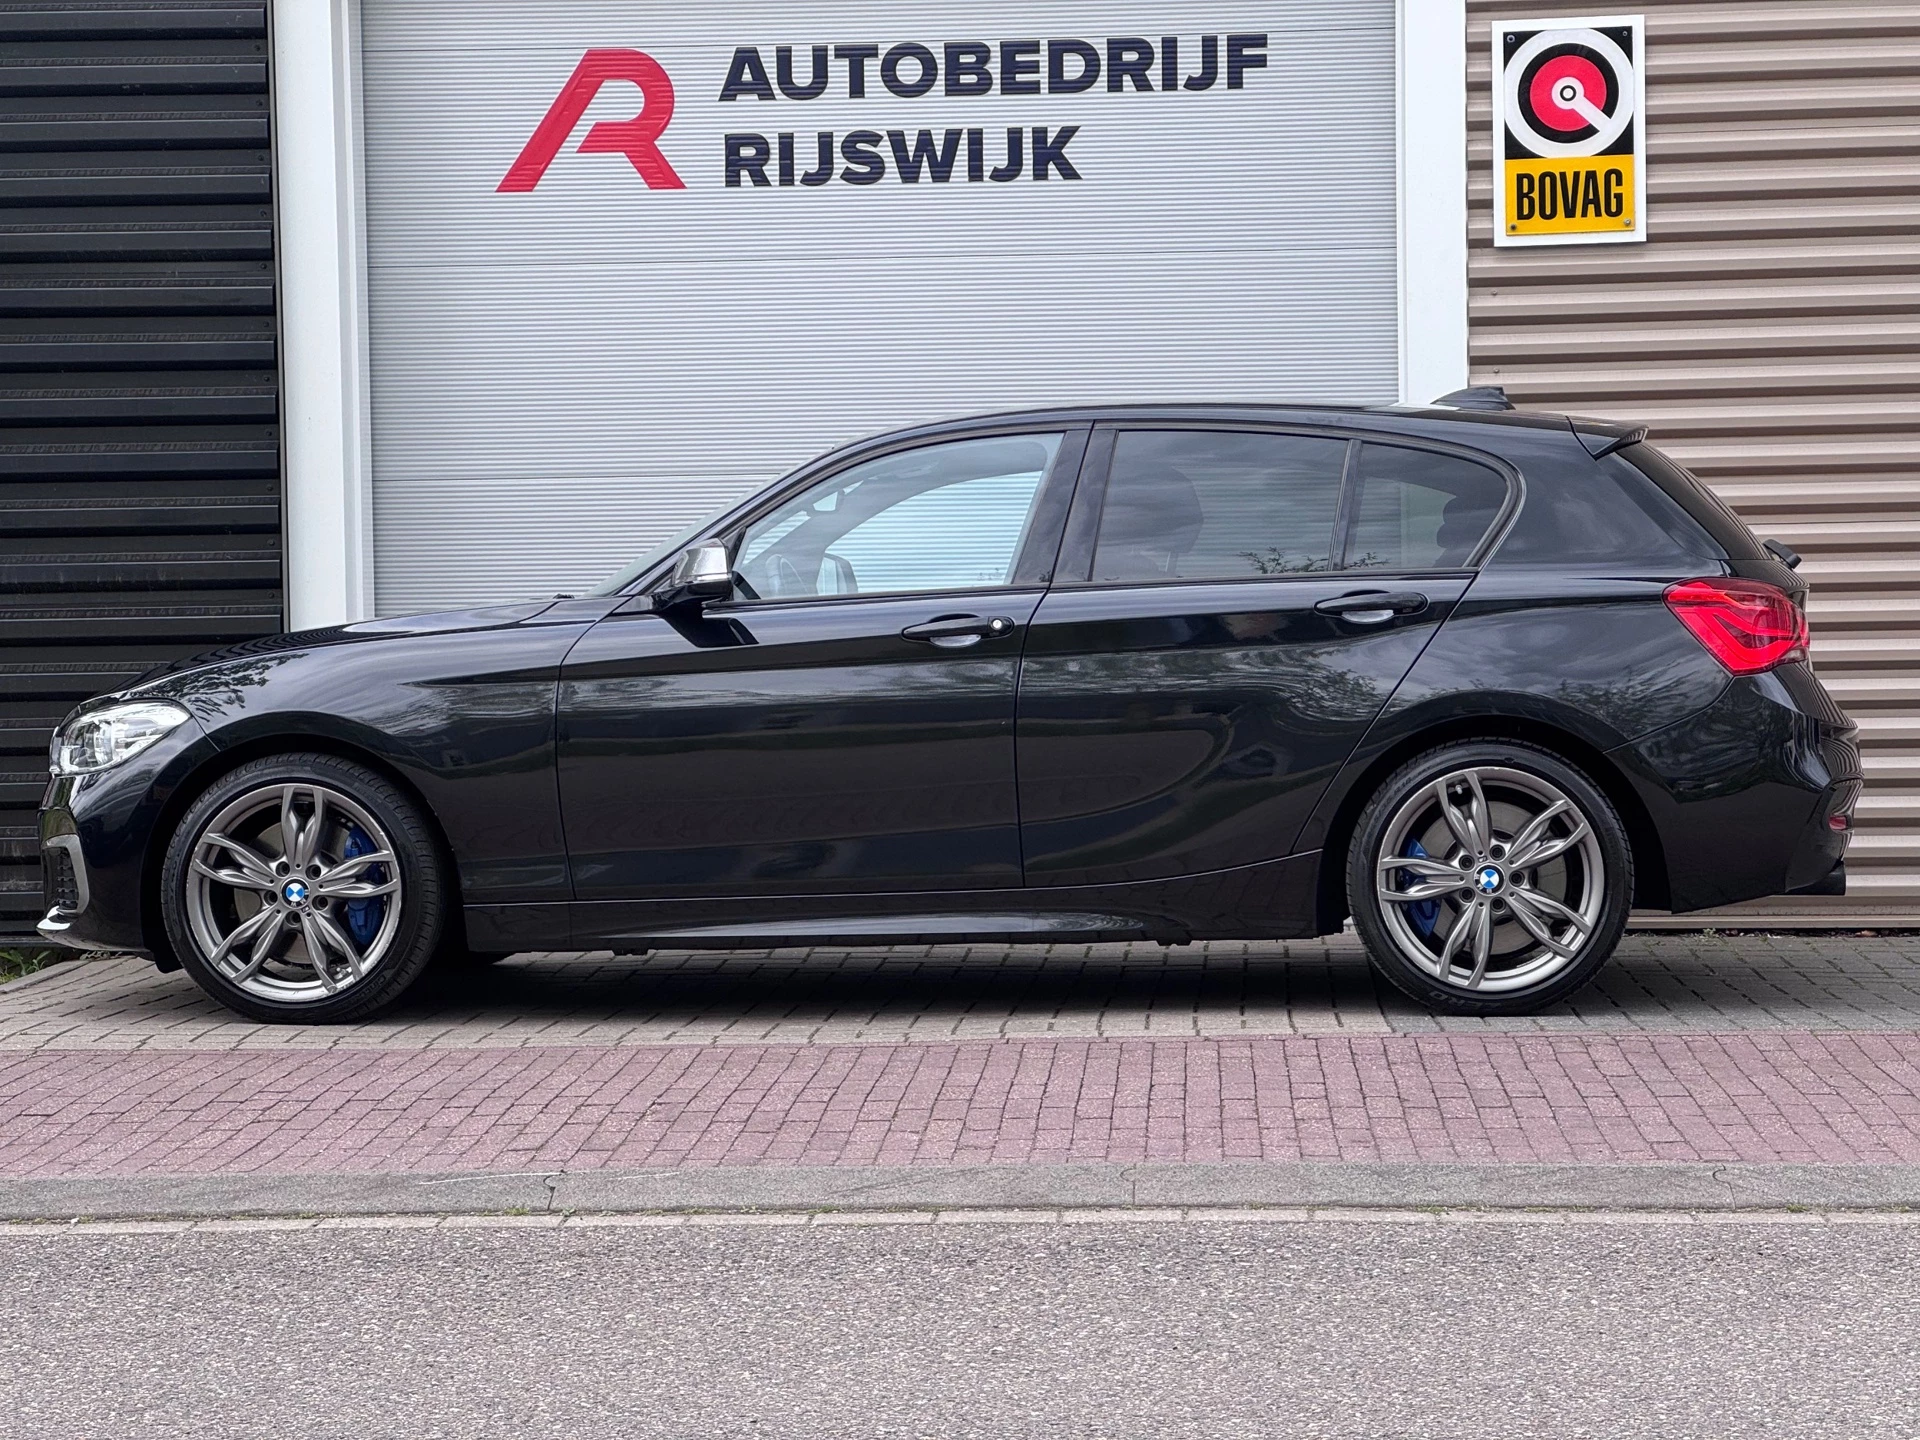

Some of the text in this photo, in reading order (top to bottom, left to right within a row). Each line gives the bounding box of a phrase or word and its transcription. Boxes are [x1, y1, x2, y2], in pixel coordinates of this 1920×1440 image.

[718, 33, 1268, 102] AUTOBEDRIJF
[725, 125, 1083, 188] RIJSWIJK
[1516, 168, 1624, 221] BOVAG
